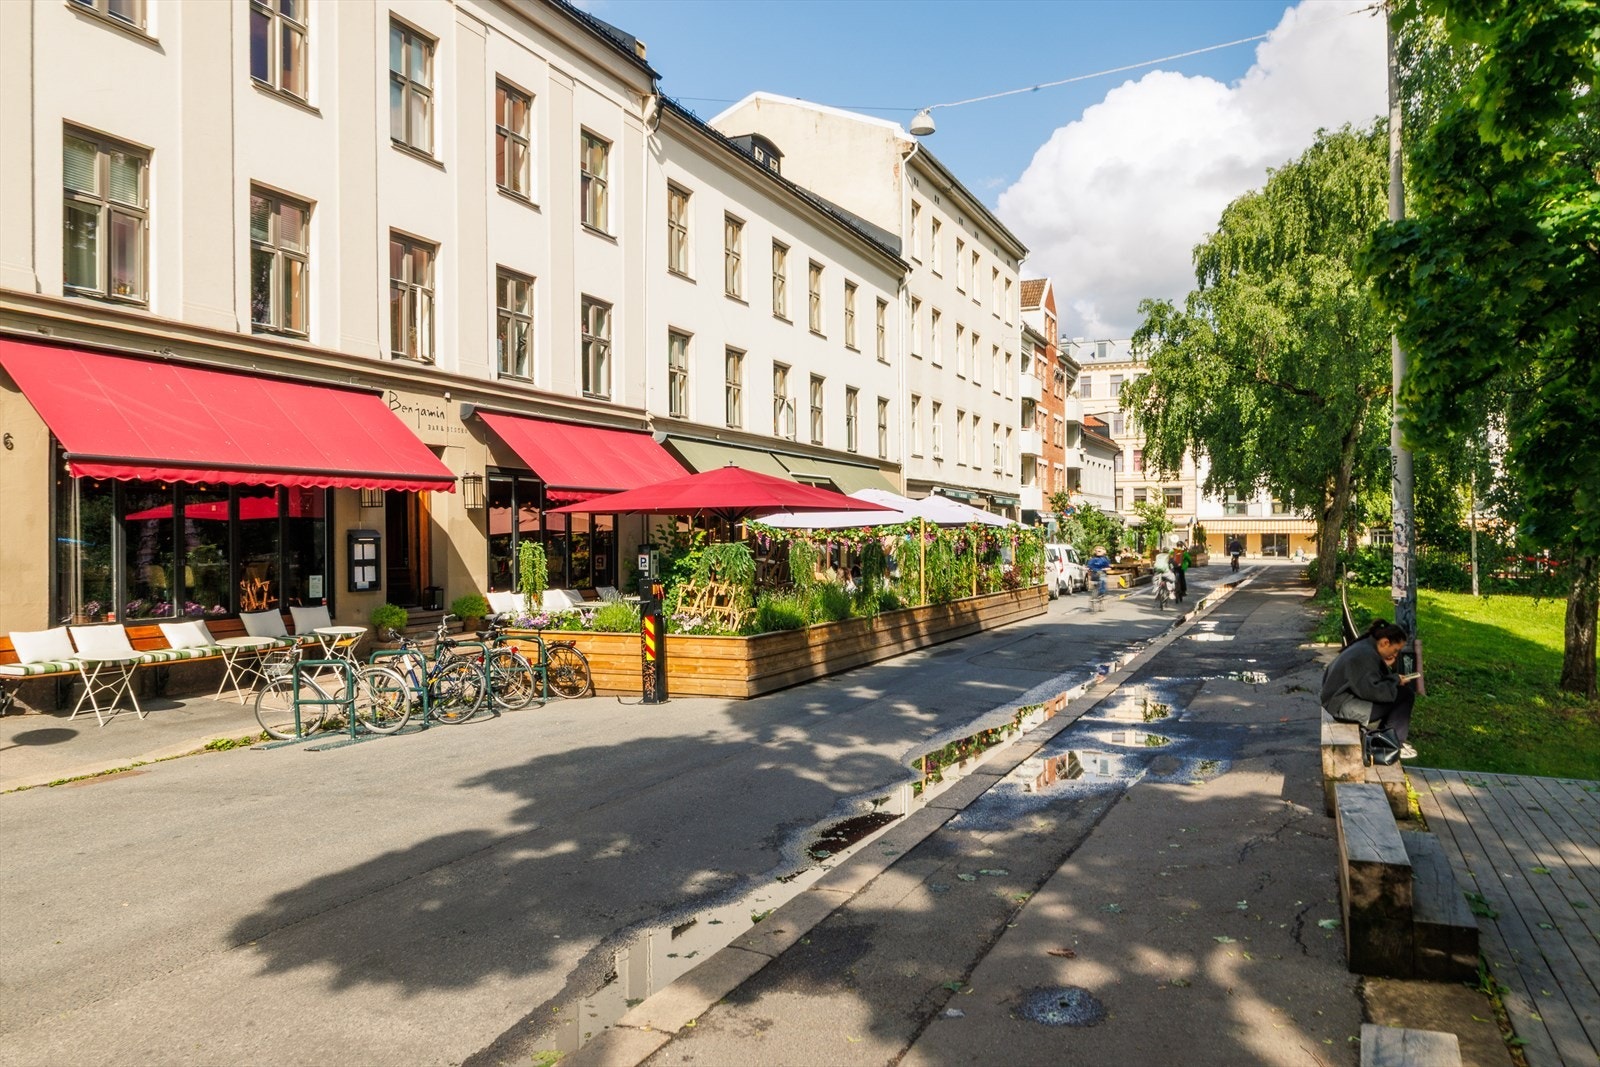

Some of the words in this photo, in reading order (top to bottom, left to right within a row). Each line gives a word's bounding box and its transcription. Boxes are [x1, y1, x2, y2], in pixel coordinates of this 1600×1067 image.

[388, 390, 446, 430] Benjamin
[3, 432, 14, 450] 6
[640, 557, 647, 568] P
